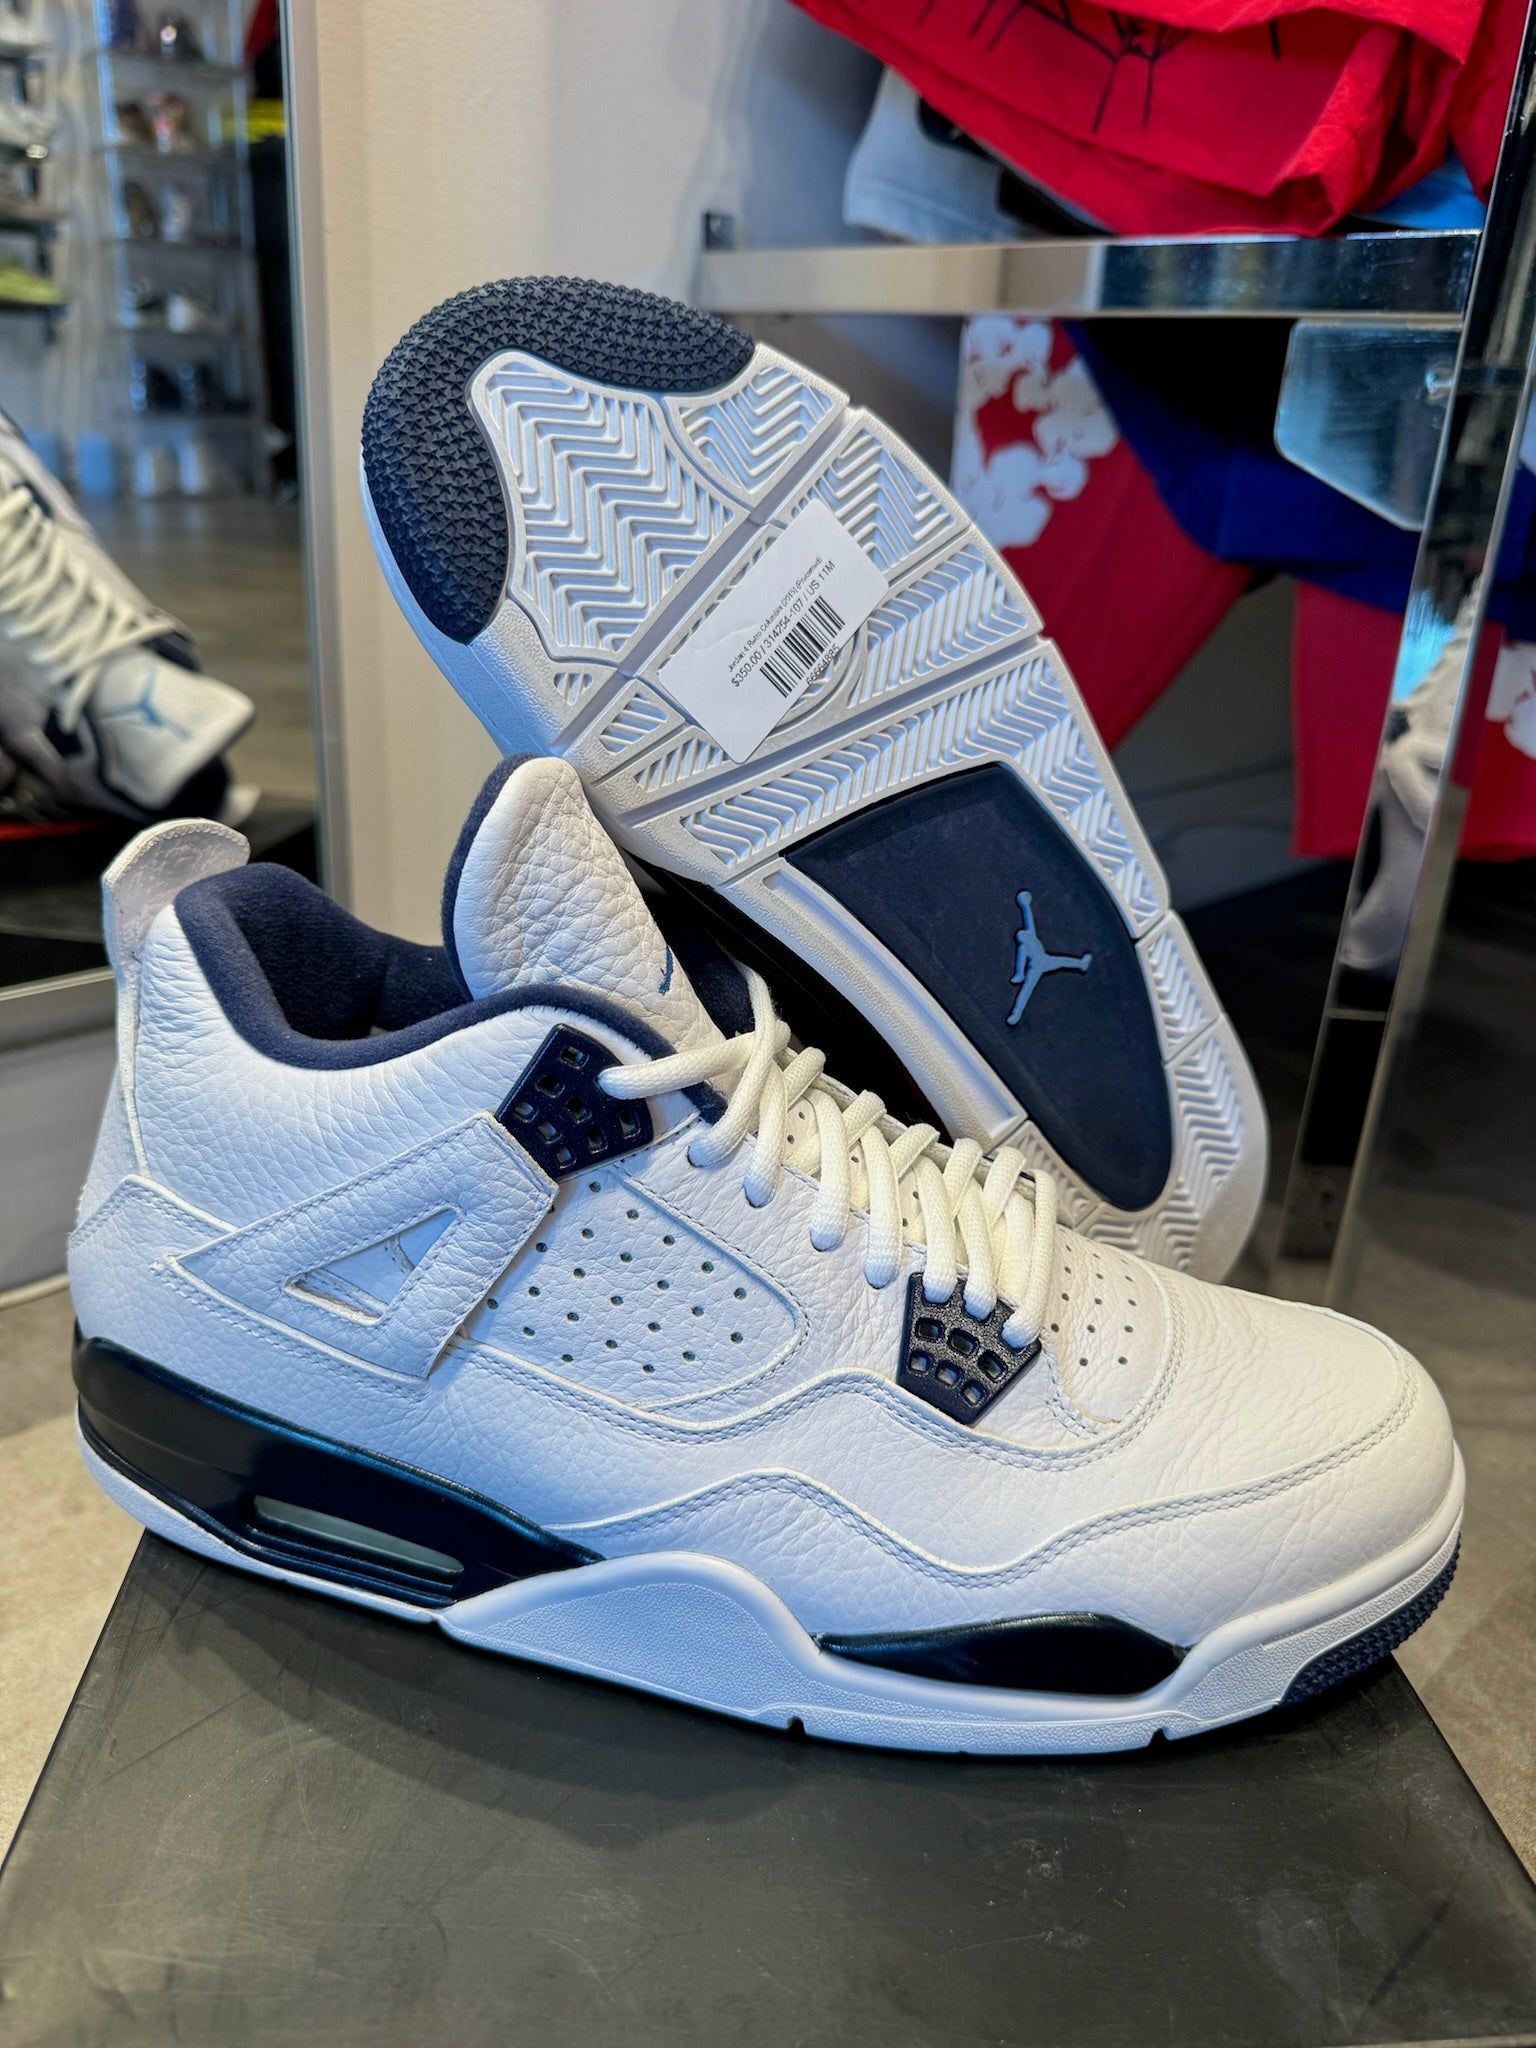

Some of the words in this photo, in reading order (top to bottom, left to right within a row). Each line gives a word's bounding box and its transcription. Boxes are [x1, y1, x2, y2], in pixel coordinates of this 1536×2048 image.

[780, 586, 799, 608] (2015)
[731, 650, 762, 688] $350.00
[763, 598, 803, 648] 314254-107
[806, 579, 820, 596] US
[818, 560, 836, 581] 11M
[806, 644, 840, 685] 66664885
